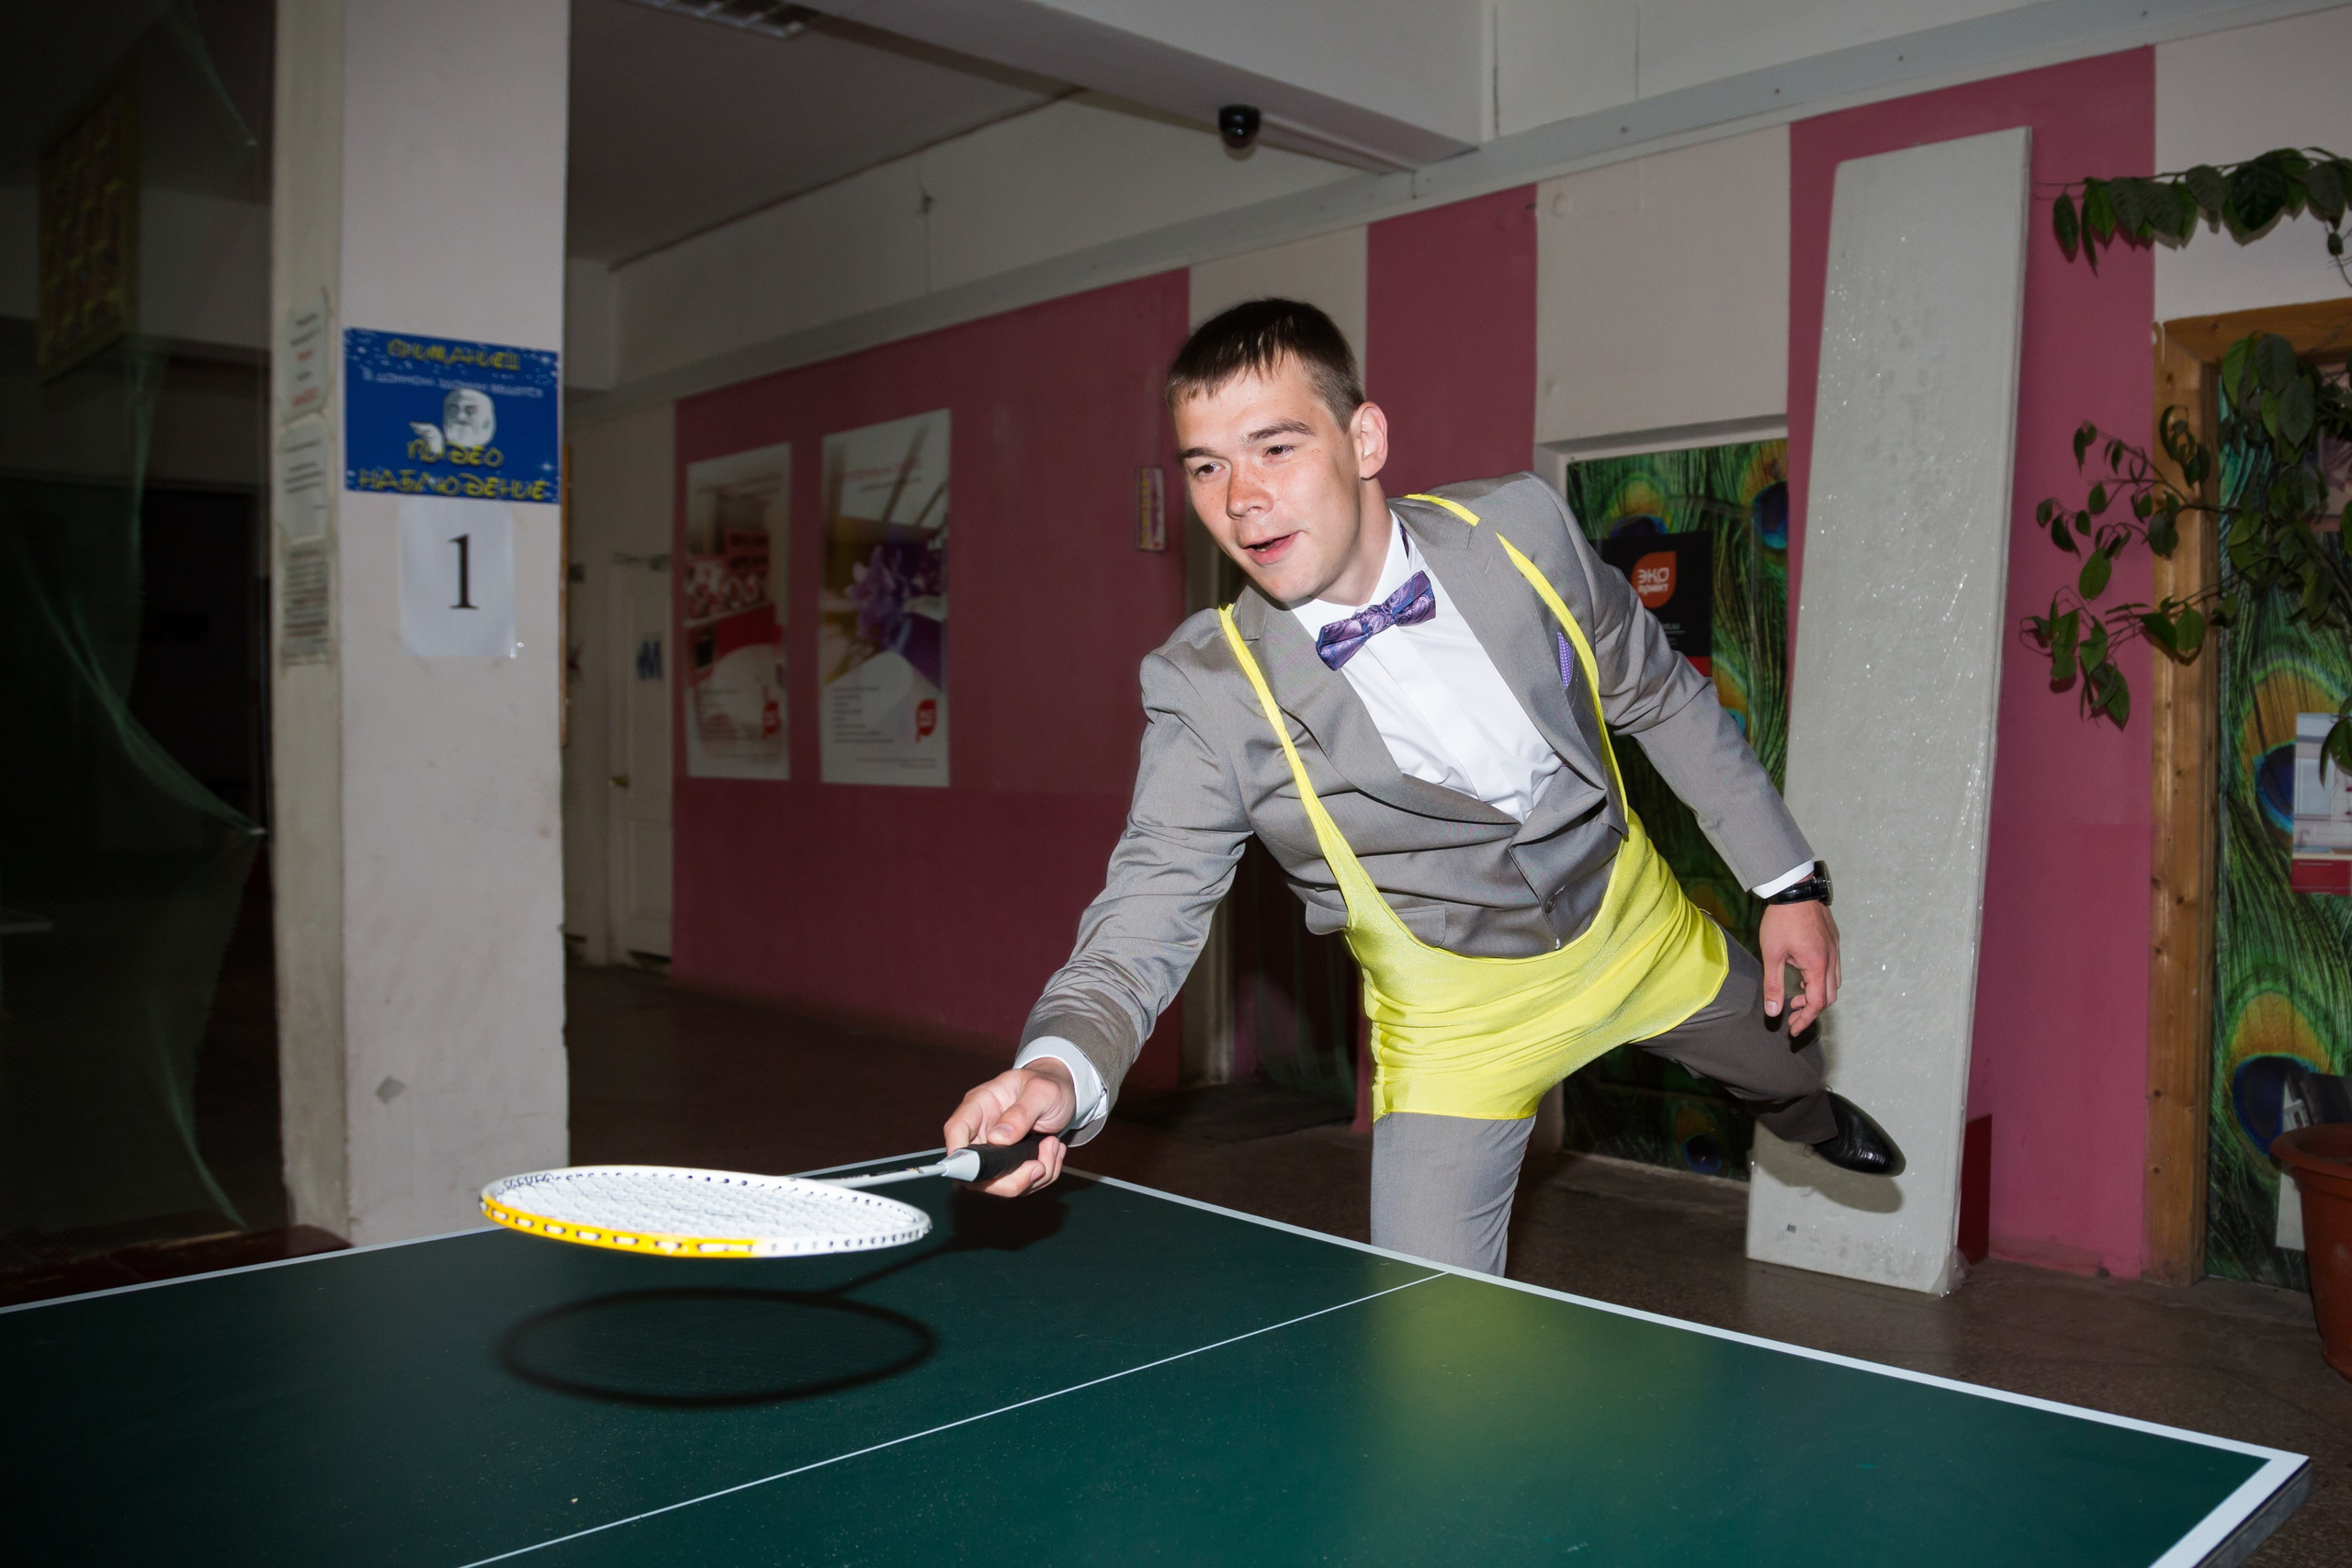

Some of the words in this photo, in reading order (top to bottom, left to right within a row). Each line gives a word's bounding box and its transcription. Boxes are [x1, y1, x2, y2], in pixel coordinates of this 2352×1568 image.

[359, 468, 547, 501] НАБЛЮДЕНИЕ
[447, 533, 480, 610] 1
[1636, 567, 1669, 583] ЭКО
